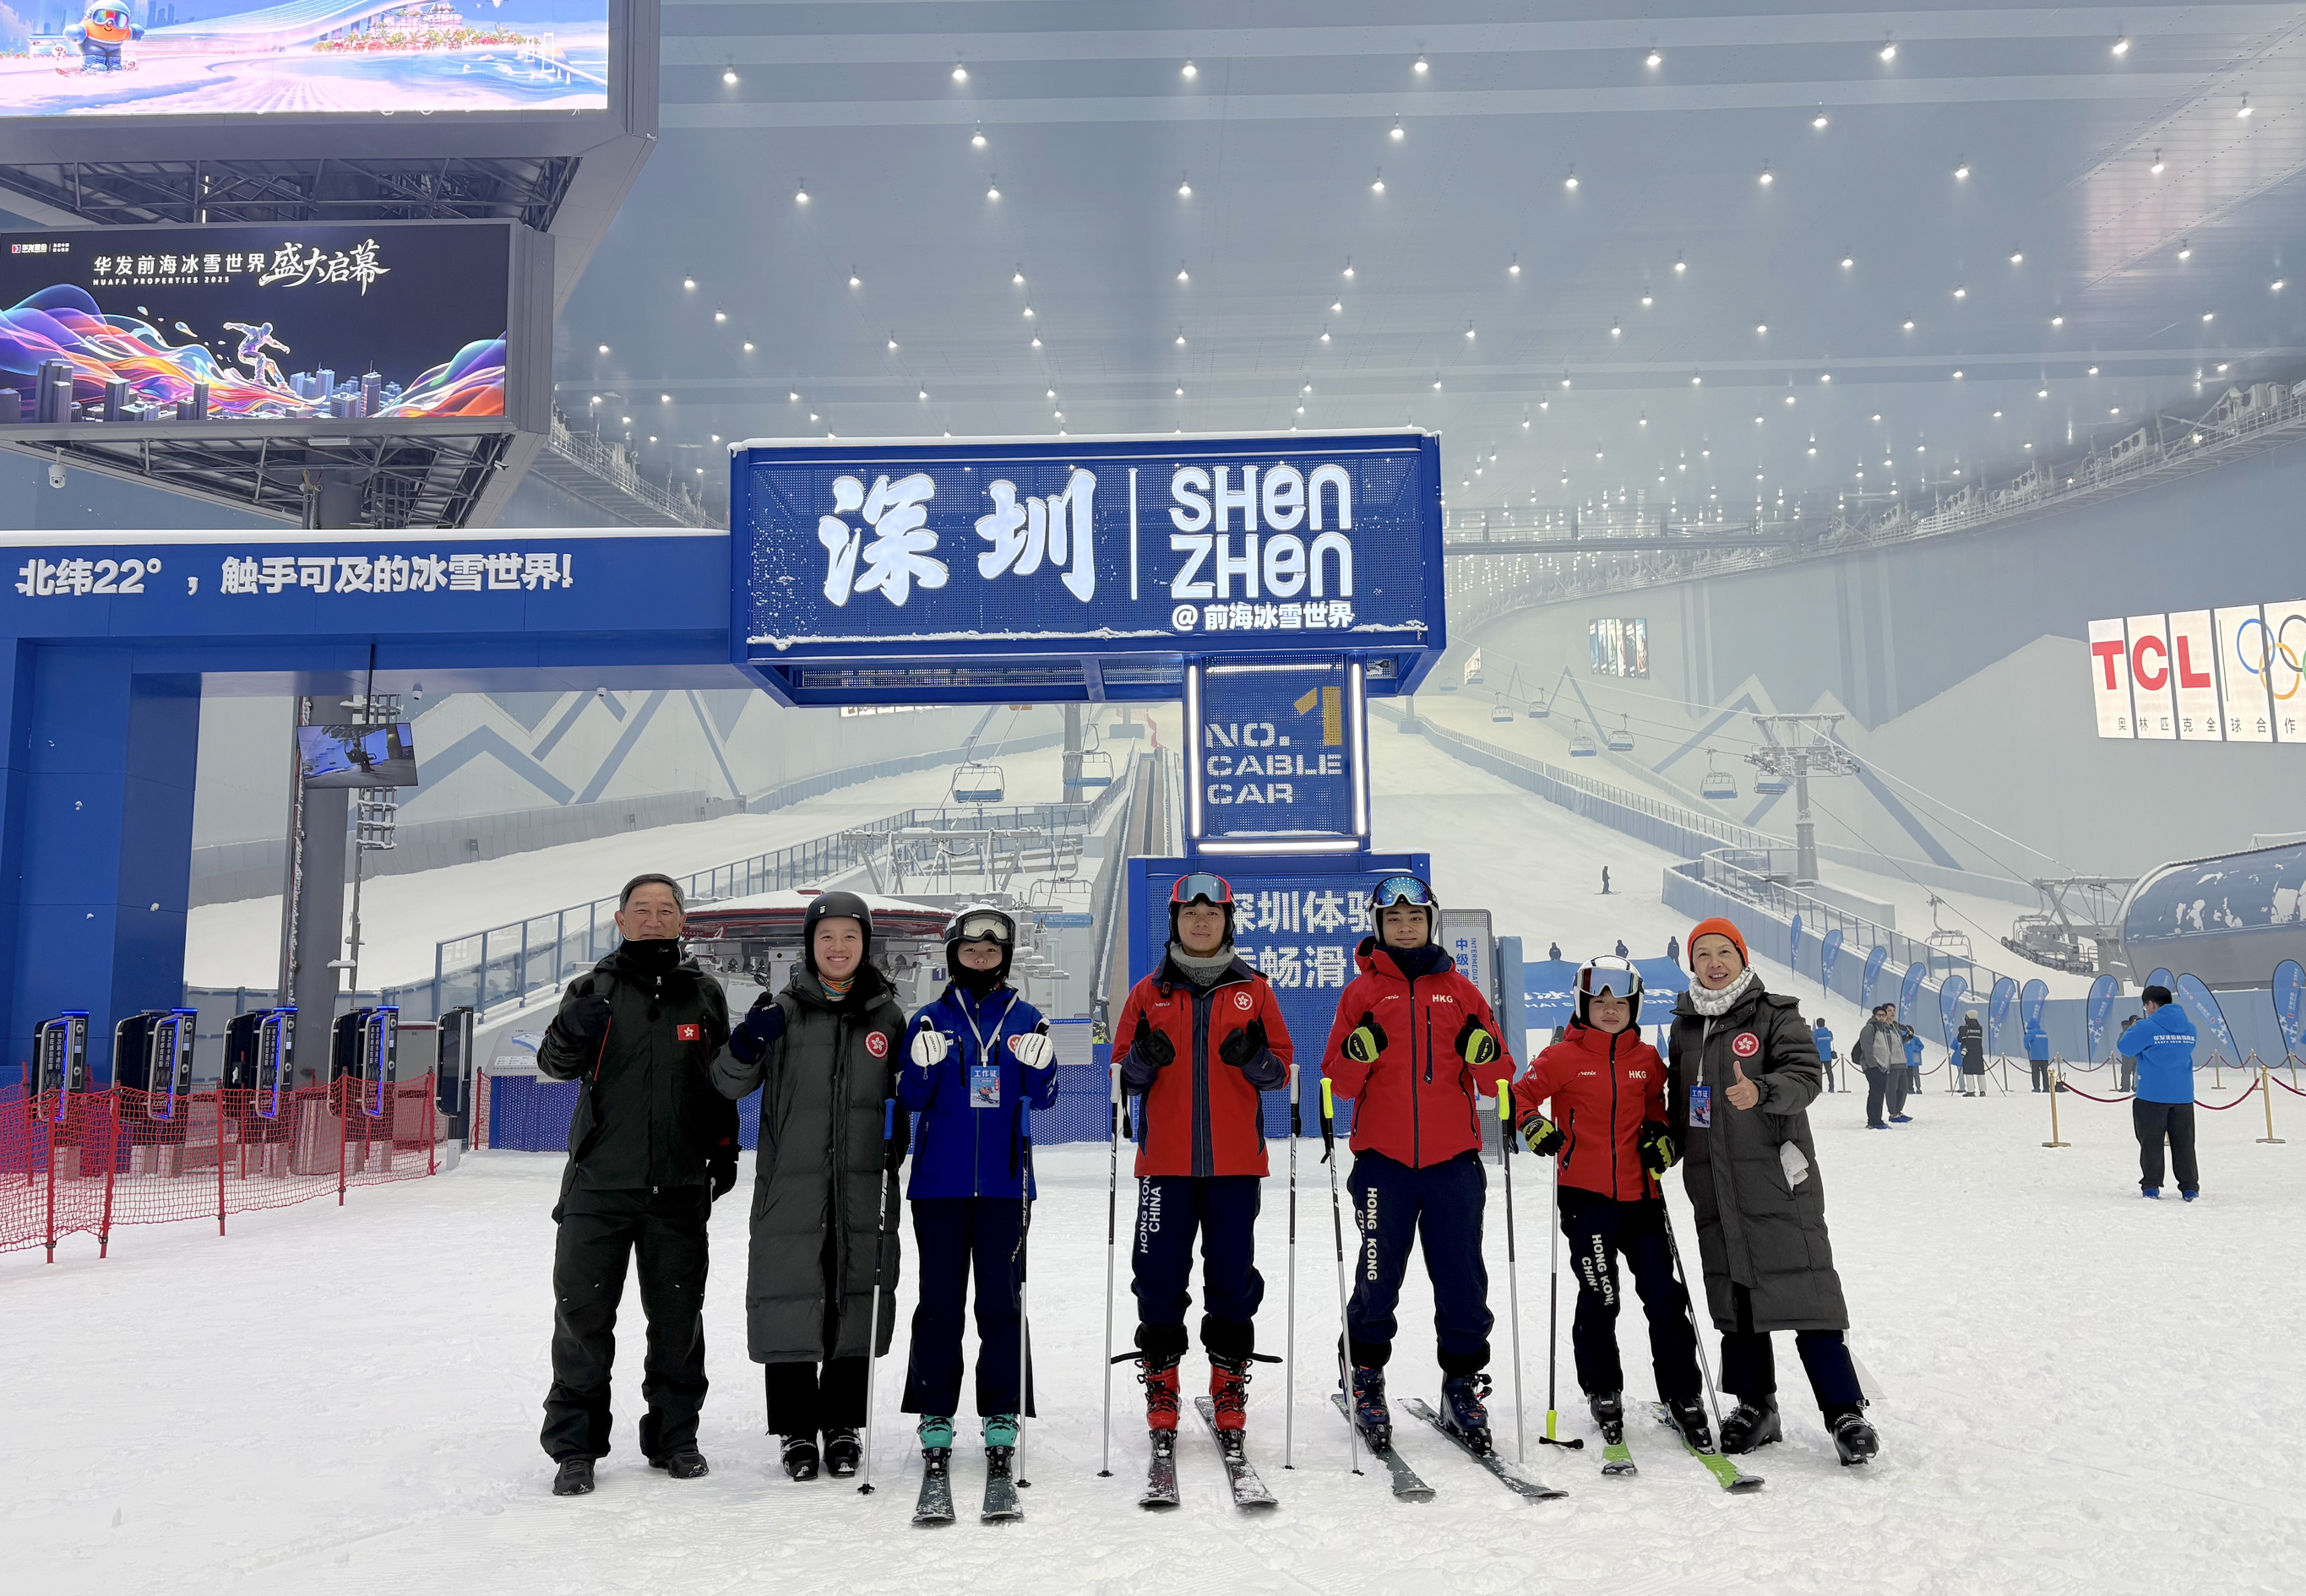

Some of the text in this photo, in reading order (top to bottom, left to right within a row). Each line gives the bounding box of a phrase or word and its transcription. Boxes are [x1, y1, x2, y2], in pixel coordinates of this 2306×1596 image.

[93, 252, 266, 276] 华发前海冰雪世界
[258, 238, 392, 297] 盛大启幕
[92, 275, 230, 286] HUAFA PROPERTIES 2025
[819, 469, 1097, 607] 深圳
[1204, 600, 1355, 630] 前海冰雪世界
[2091, 635, 2211, 691] TCL
[1205, 686, 1343, 746] NO. 1
[2118, 716, 2297, 735] 奥林匹克全球合作
[1206, 754, 1343, 776] CABLE
[1207, 783, 1294, 805] CAR
[1432, 994, 1454, 1003] HKG
[974, 1069, 998, 1078] 工作证
[1629, 1070, 1647, 1079] HKG
[1139, 1175, 1150, 1254] HONG KON
[1149, 1186, 1161, 1233] CHINA
[1367, 1187, 1378, 1281] HONG KONG
[1591, 1234, 1607, 1273] HONG
